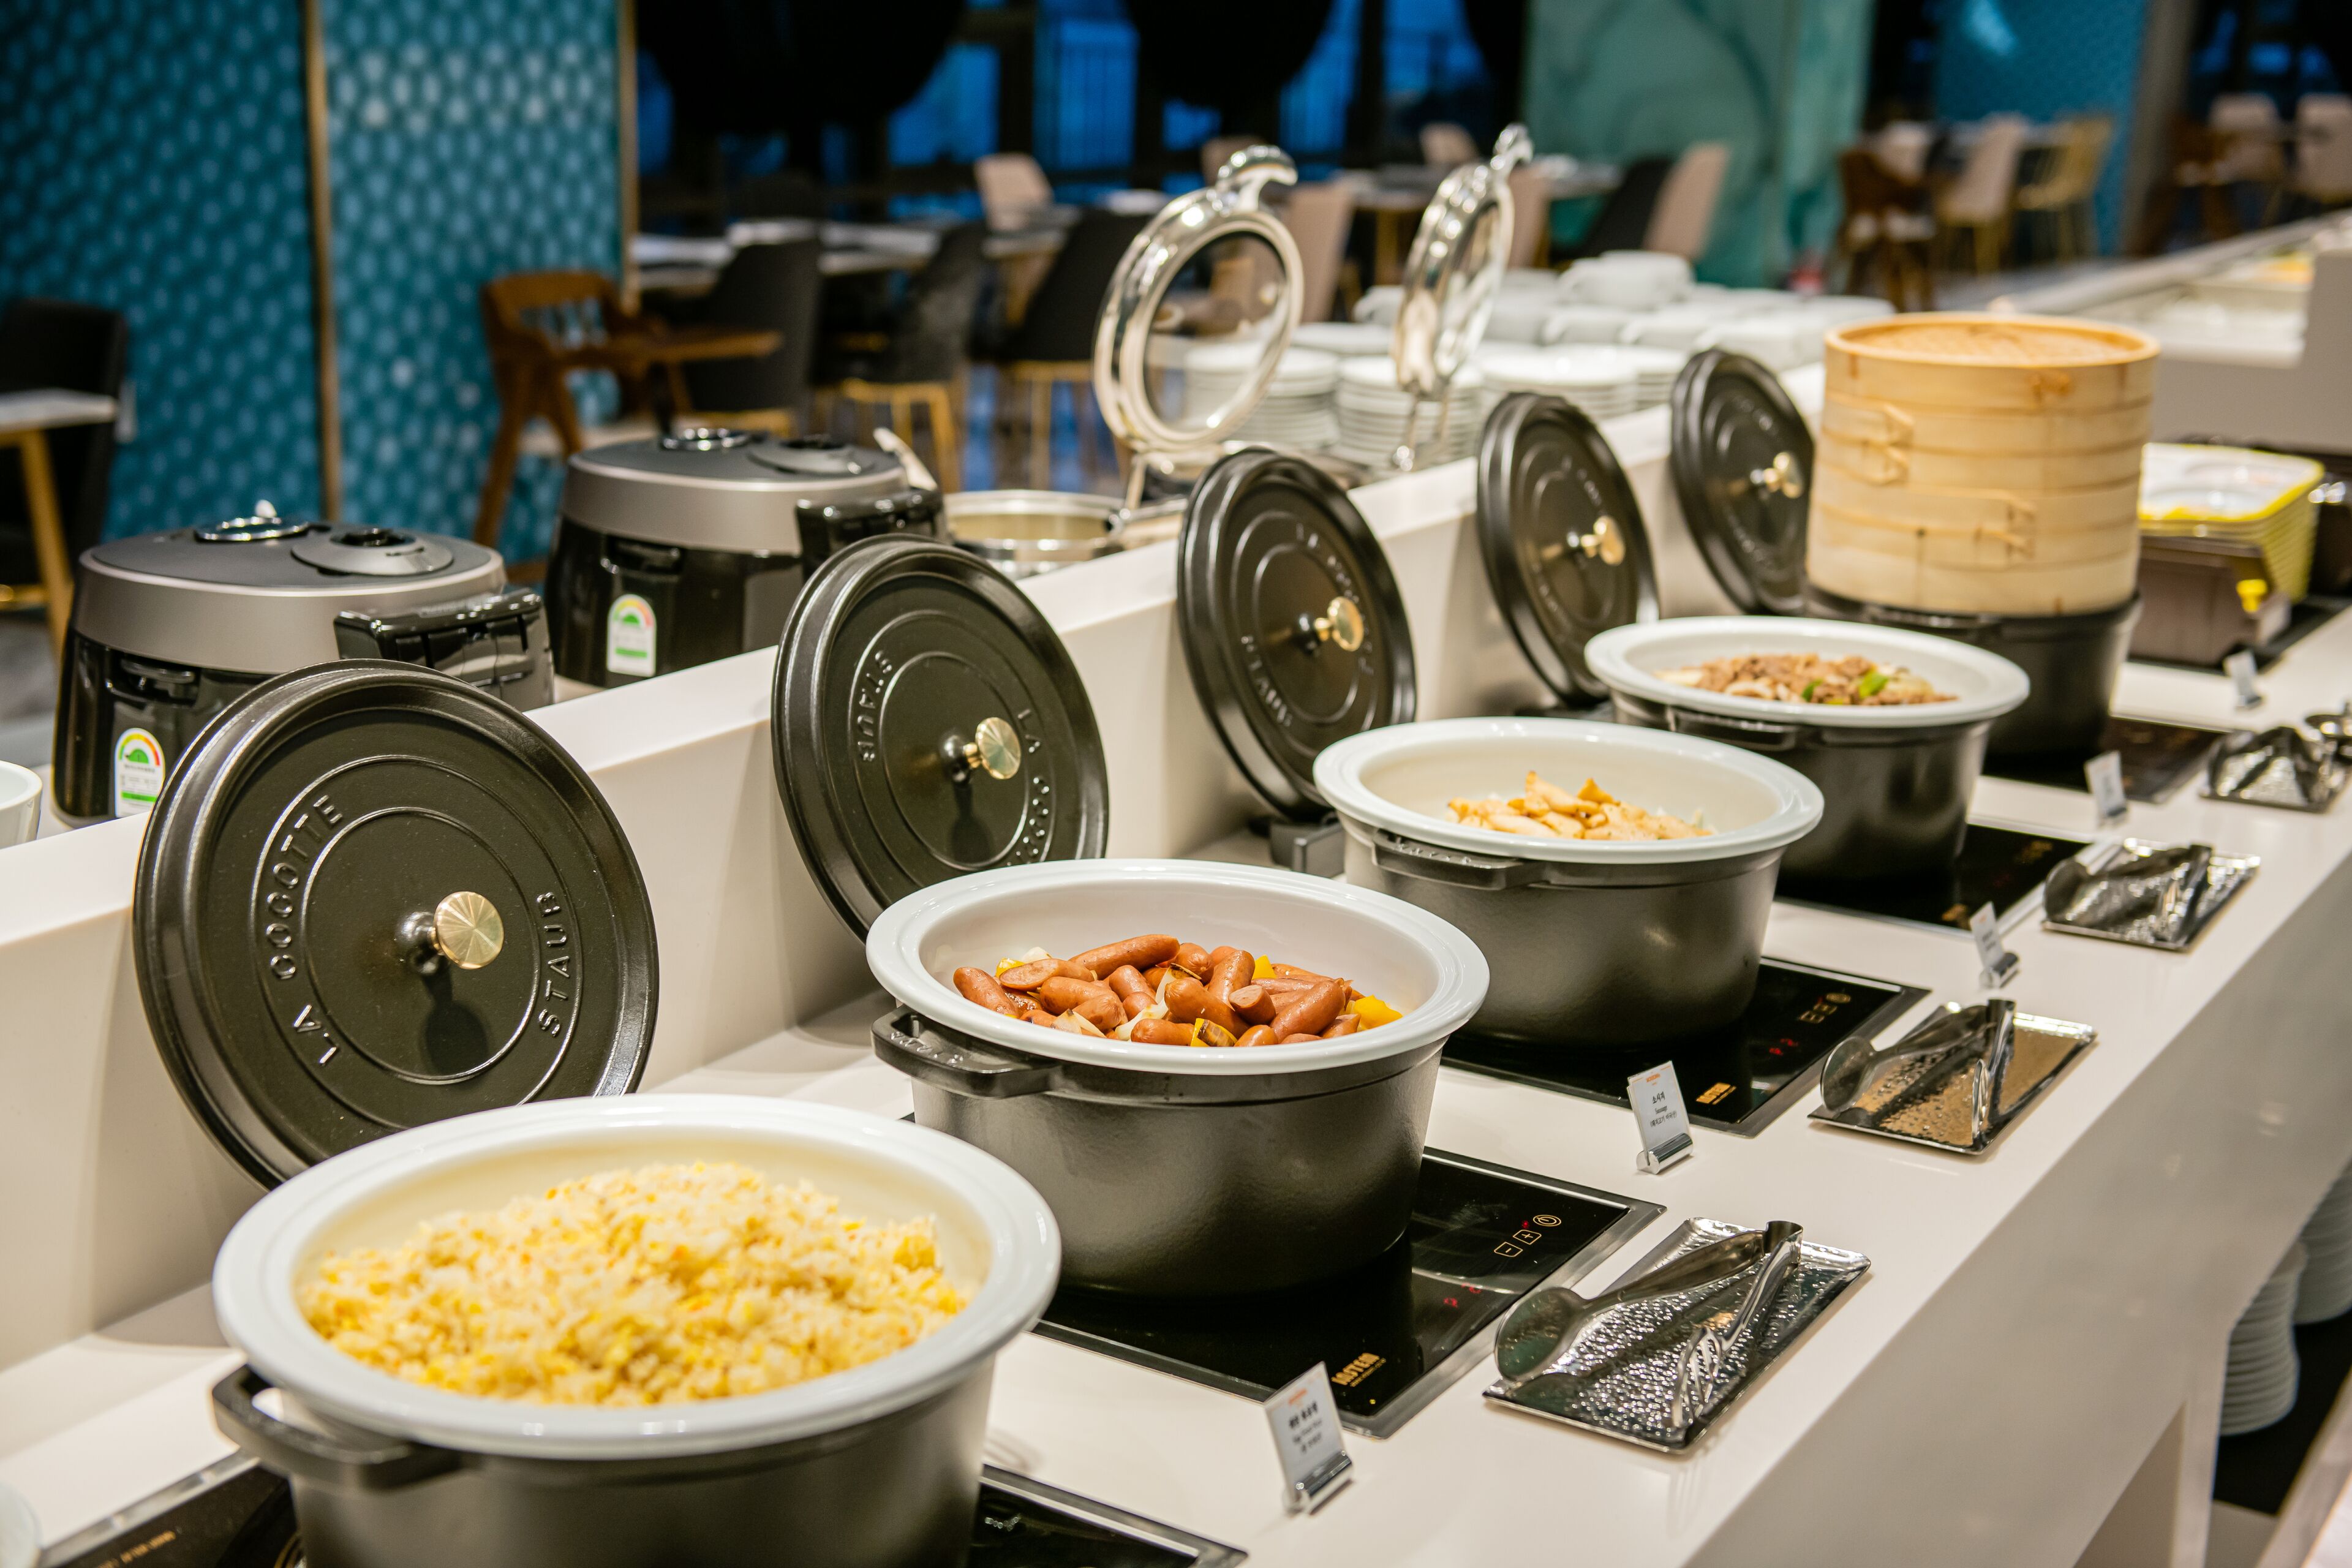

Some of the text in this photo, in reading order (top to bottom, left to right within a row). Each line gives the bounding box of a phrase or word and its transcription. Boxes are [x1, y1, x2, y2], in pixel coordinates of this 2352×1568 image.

[266, 794, 344, 1065] LA COCOTTE
[537, 892, 570, 1037] STAUB
